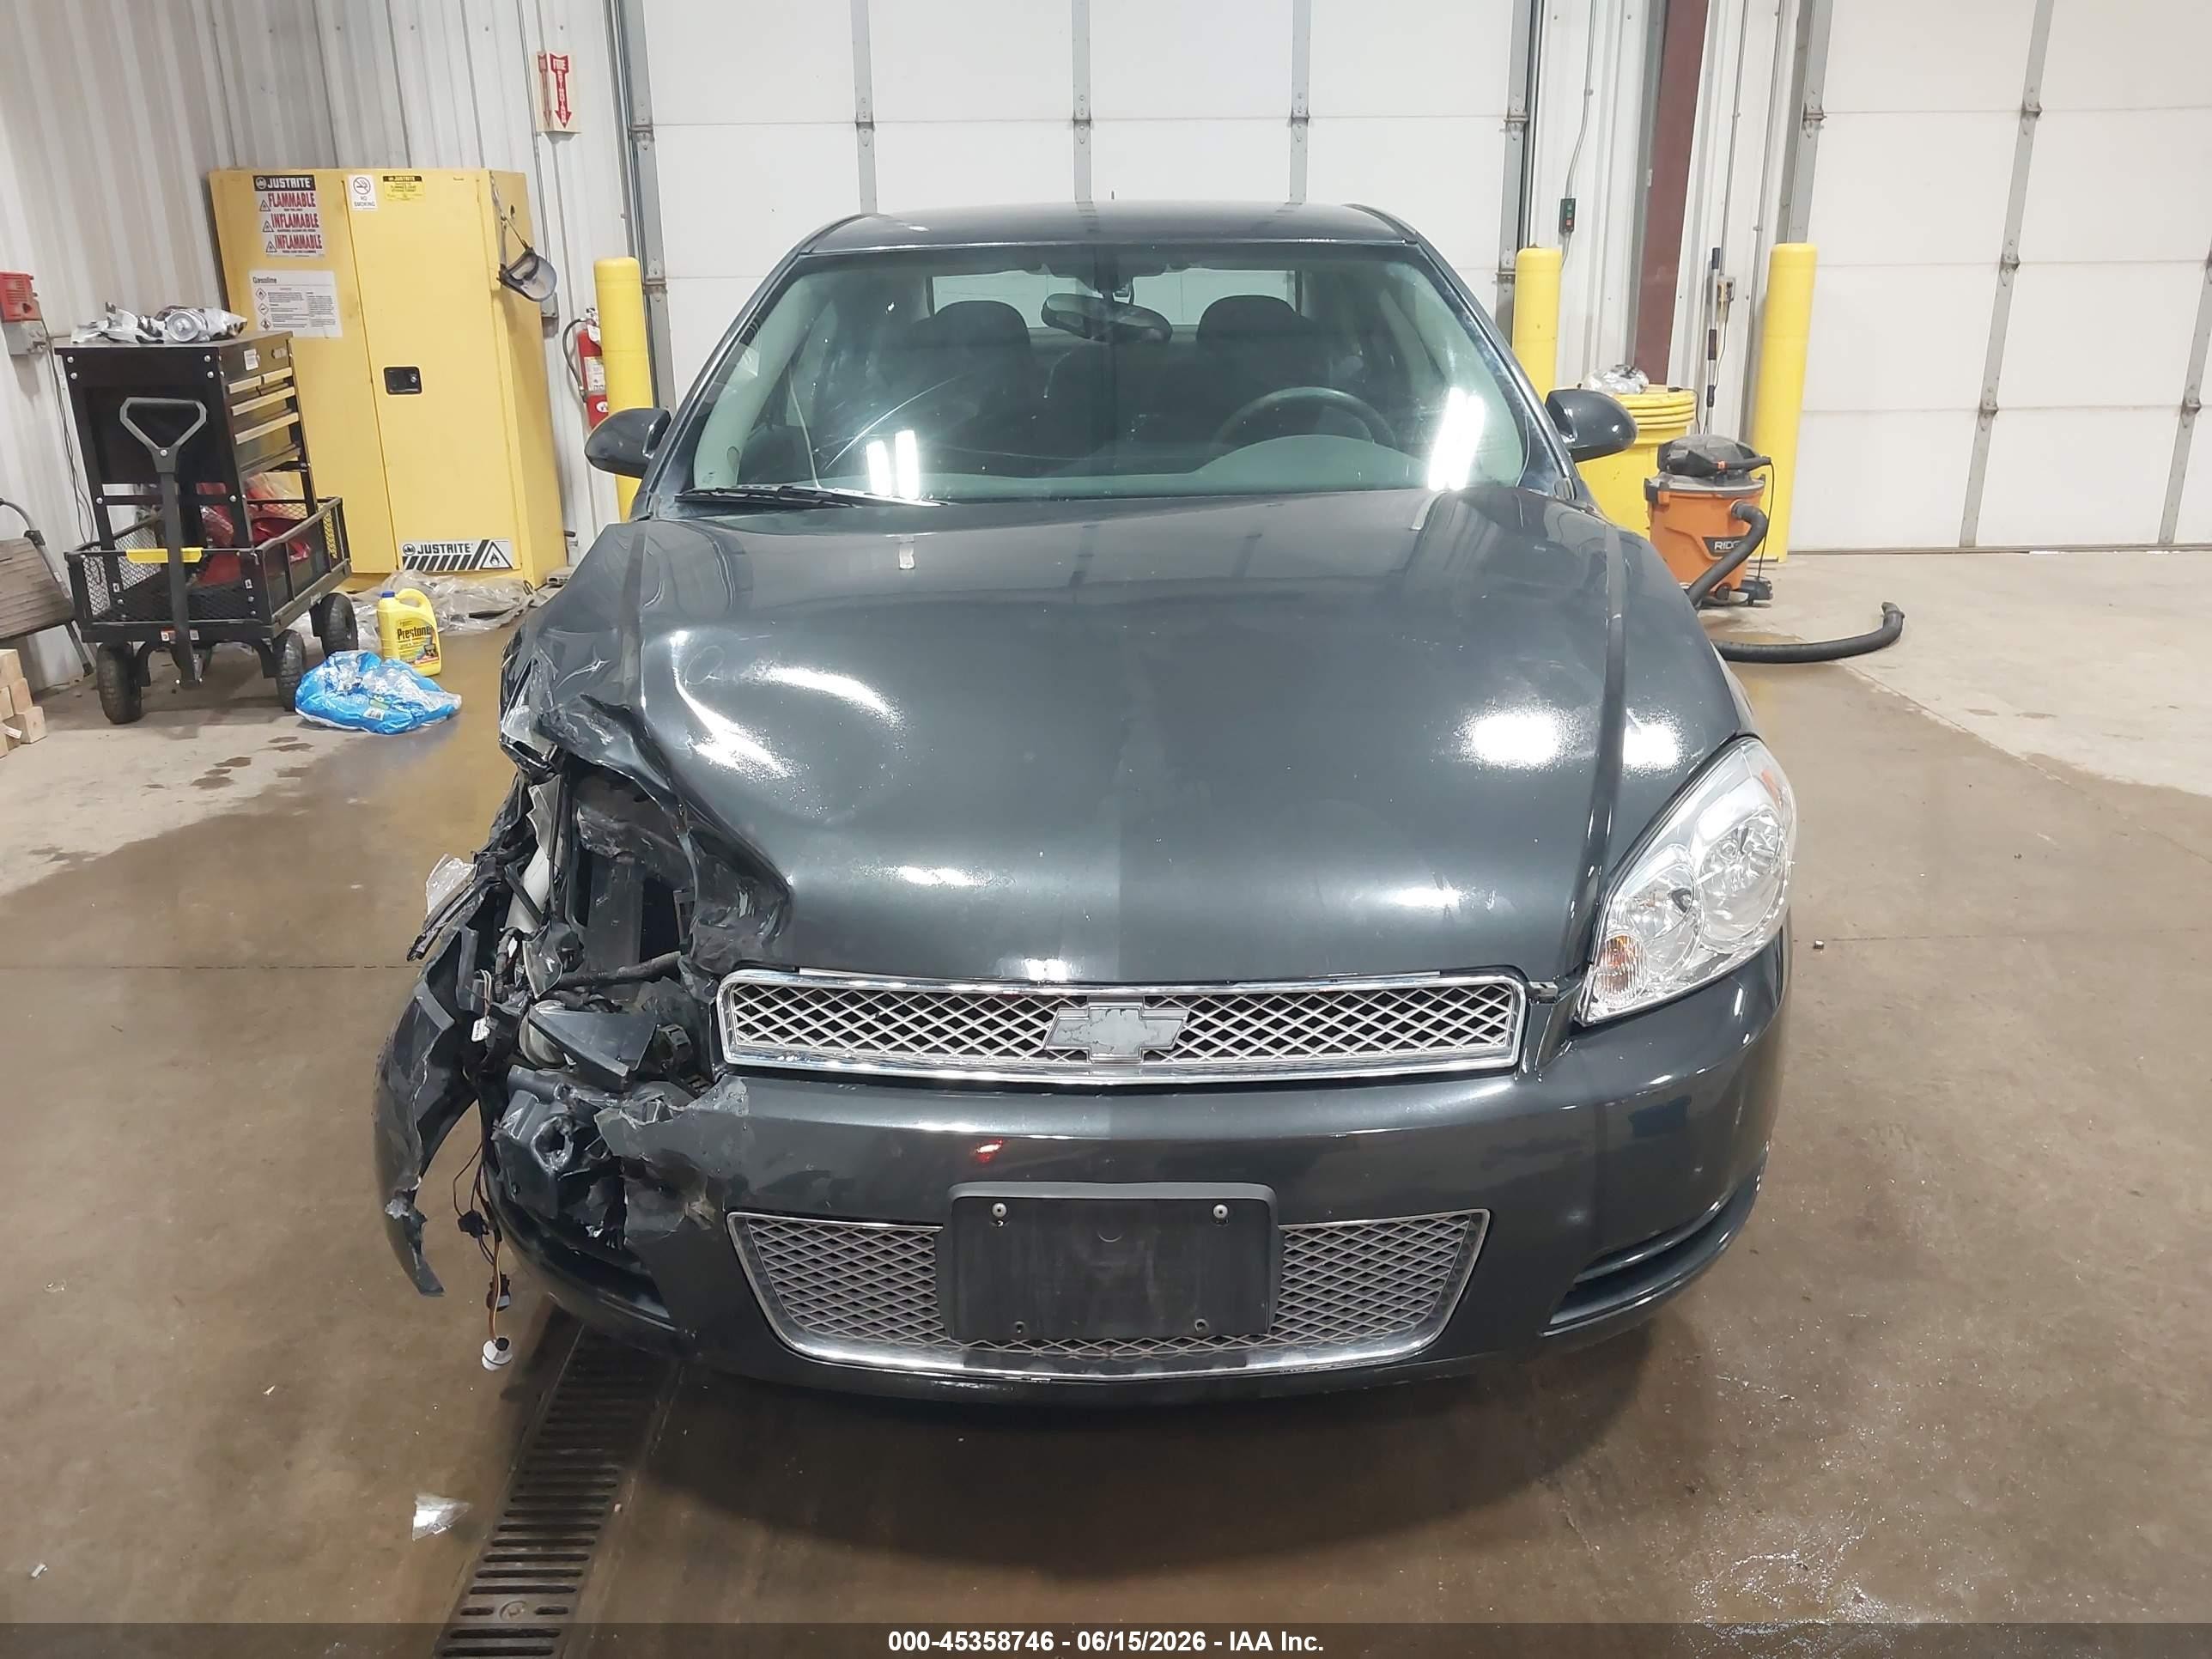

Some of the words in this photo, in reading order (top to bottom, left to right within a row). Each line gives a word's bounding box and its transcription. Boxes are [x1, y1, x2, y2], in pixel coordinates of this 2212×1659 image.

[268, 178, 311, 189] JUSTRITE
[268, 192, 317, 207] FLAMMABLE
[271, 213, 319, 228] INFLAMABLE
[275, 234, 323, 249] INFLAMMABLE
[417, 544, 471, 554] JUSTRITE
[397, 626, 431, 640] Prestone
